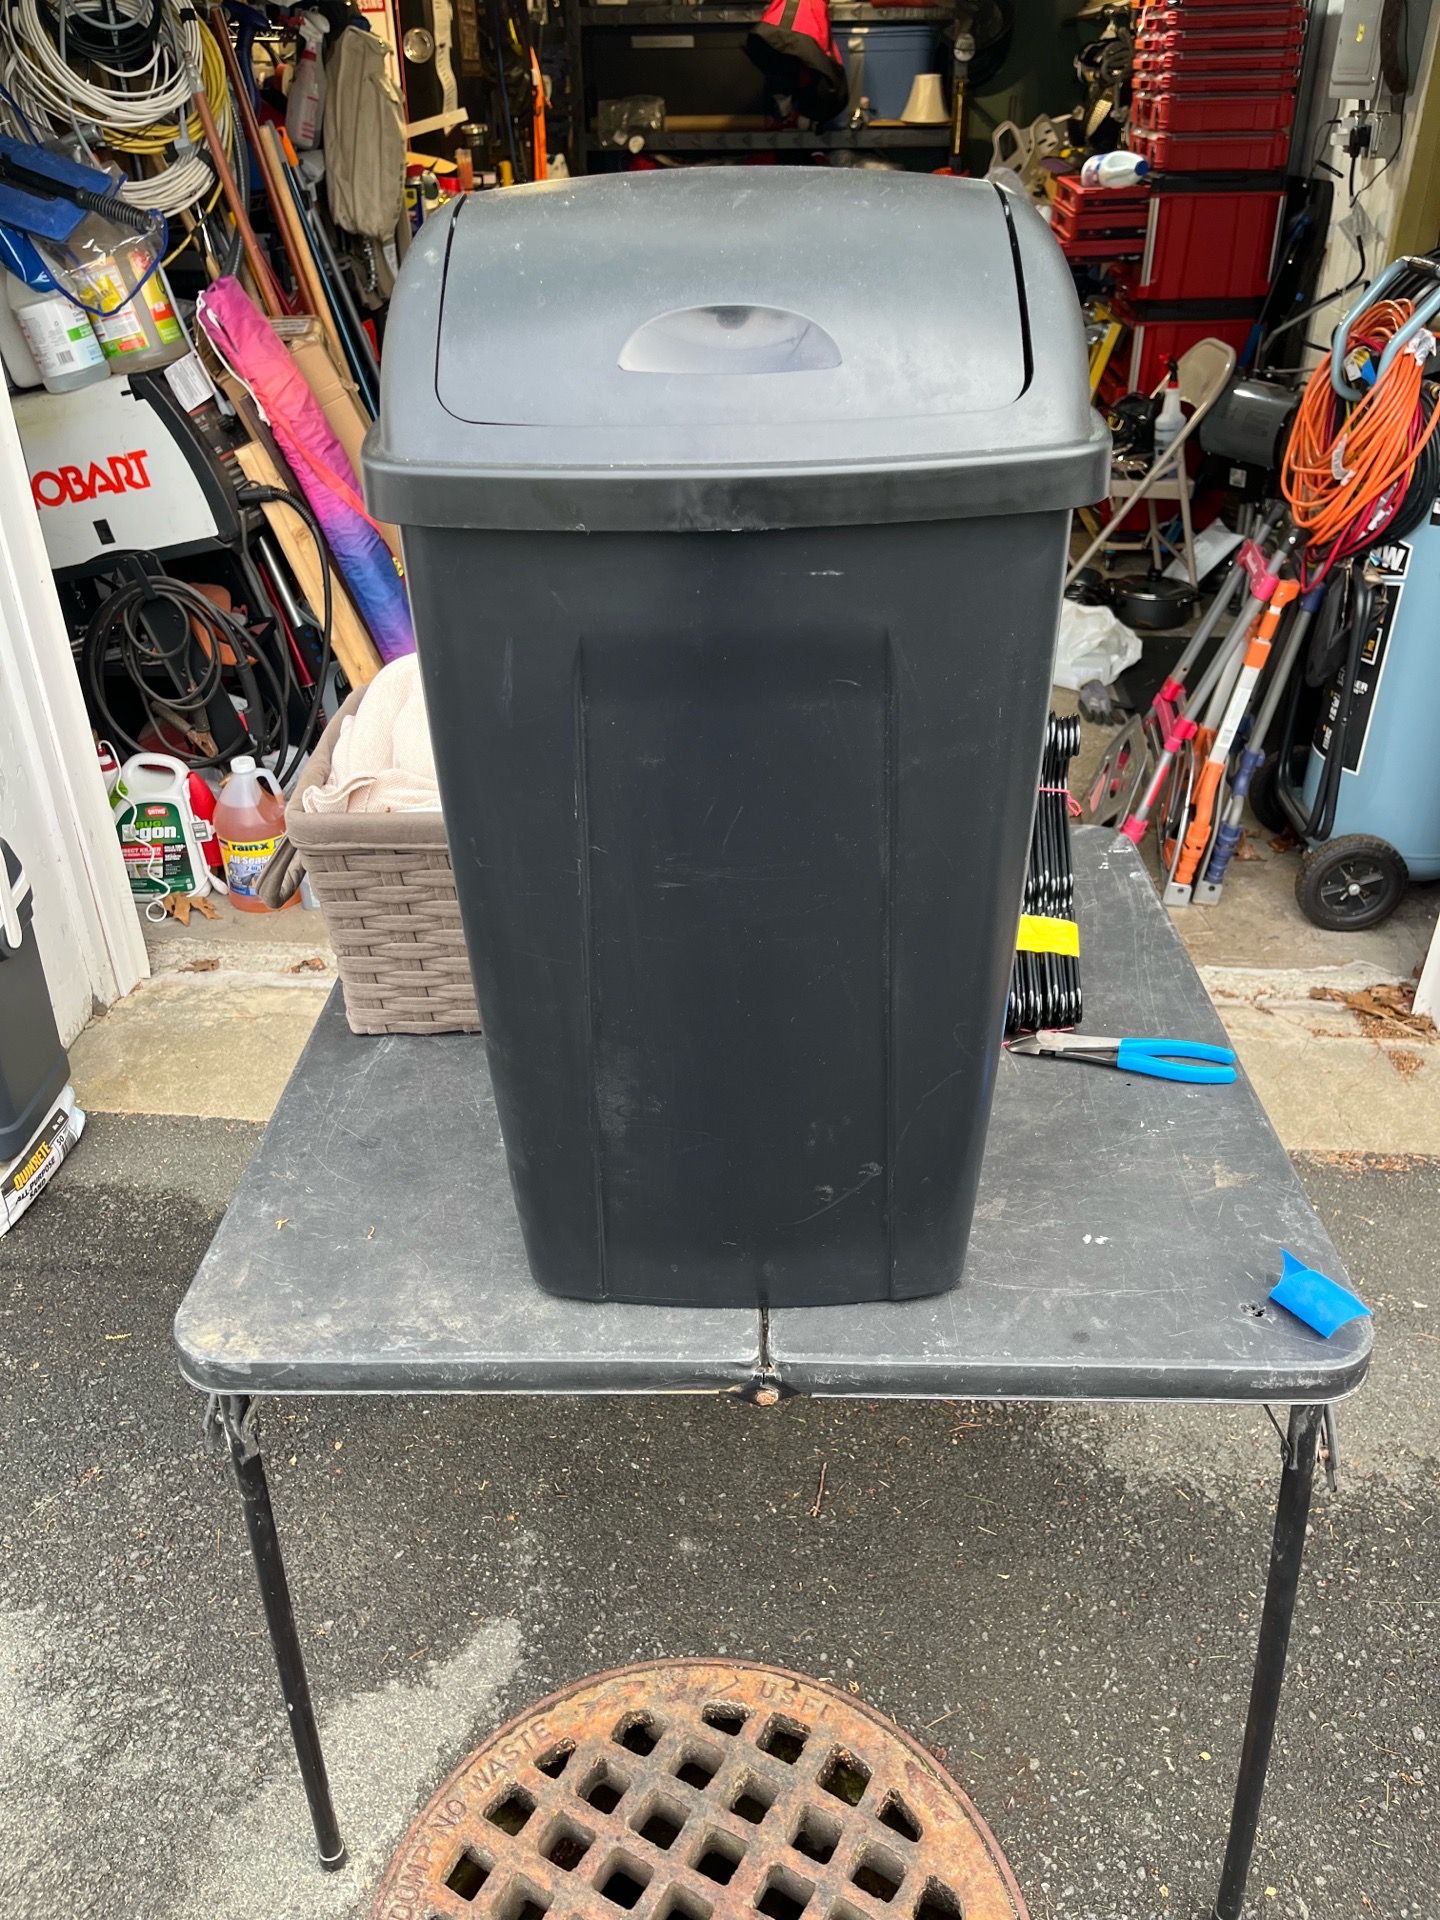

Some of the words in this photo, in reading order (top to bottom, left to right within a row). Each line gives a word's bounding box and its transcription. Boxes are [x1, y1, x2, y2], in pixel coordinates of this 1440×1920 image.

[32, 449, 151, 510] OBART
[13, 1141, 52, 1192] QUIKRETE
[16, 1156, 55, 1205] ALL-PURPOSE
[388, 1845, 434, 1920] DUMP
[429, 1797, 468, 1840] NO
[467, 1717, 553, 1794] WASTE
